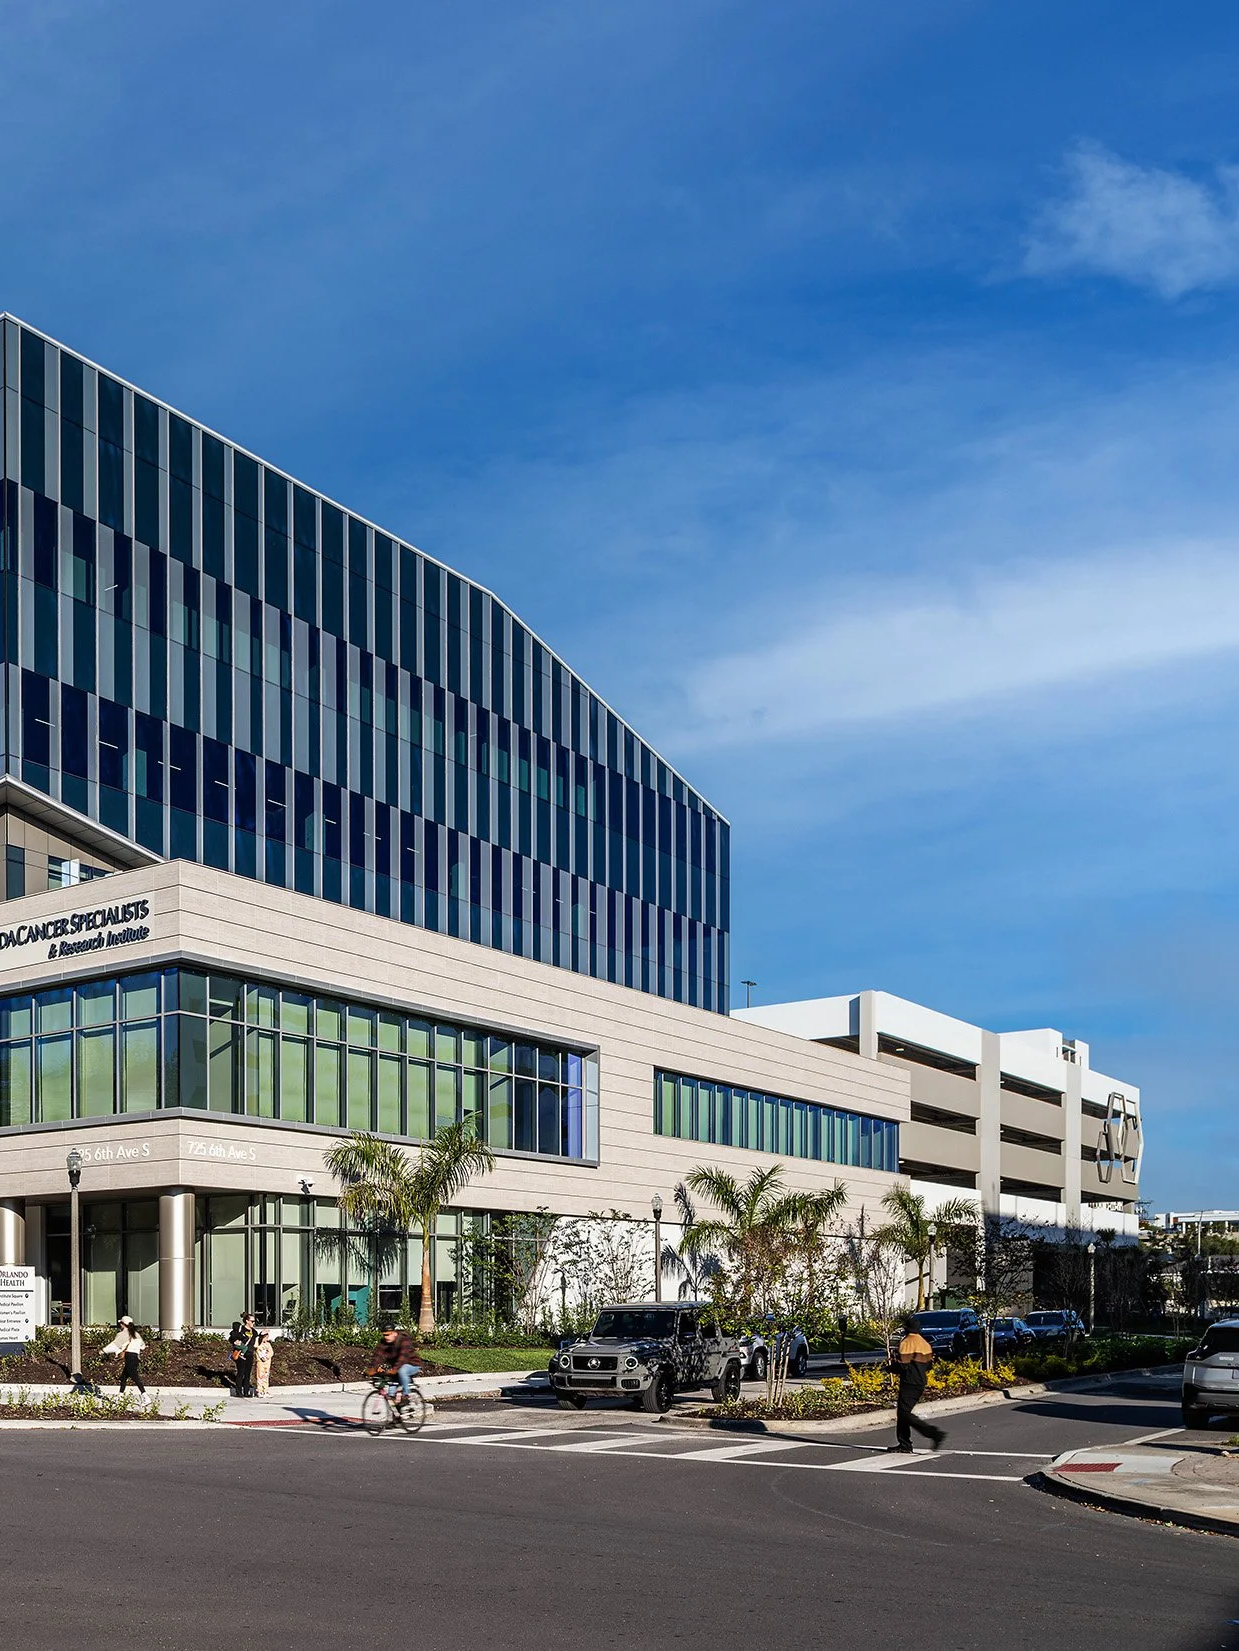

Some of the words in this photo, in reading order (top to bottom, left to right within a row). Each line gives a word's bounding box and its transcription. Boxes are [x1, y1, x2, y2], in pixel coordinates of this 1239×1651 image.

[16, 917, 70, 946] CANCER
[70, 899, 150, 935] SPECIALISTS
[48, 943, 58, 959] &
[58, 931, 105, 957] Research
[106, 925, 150, 948] Institute
[94, 1146, 113, 1161] 6th
[116, 1145, 139, 1159] Ave
[141, 1143, 150, 1157] S
[187, 1141, 207, 1156] 725
[209, 1143, 226, 1158] 6th
[227, 1145, 247, 1160] Ave
[249, 1147, 257, 1161] S
